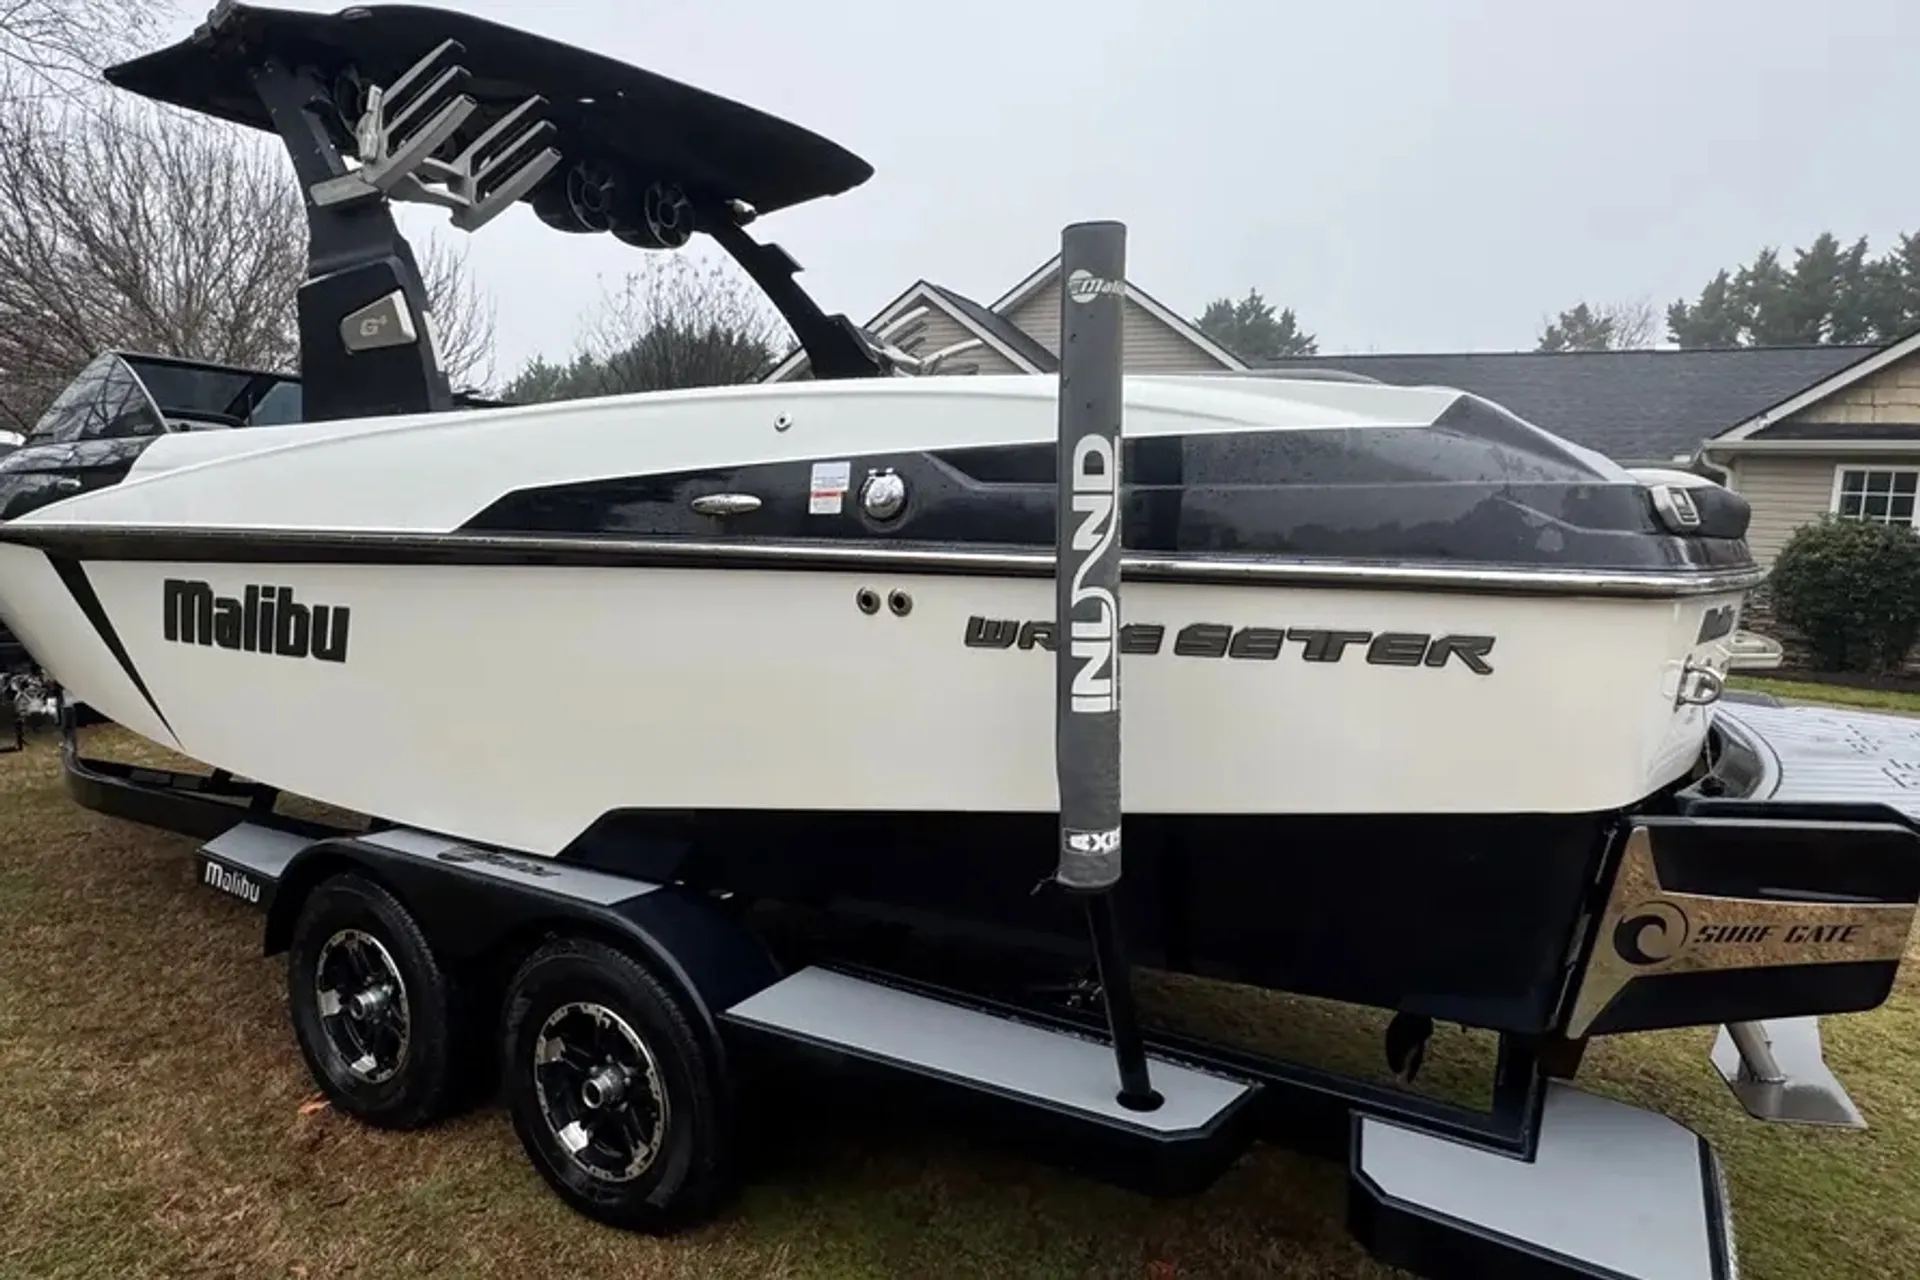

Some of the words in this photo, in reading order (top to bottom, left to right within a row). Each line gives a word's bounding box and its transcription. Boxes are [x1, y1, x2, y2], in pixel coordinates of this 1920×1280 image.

[163, 578, 350, 663] Malibu
[963, 615, 1165, 654] WAE
[1173, 622, 1496, 676] SETTER
[204, 861, 260, 903] Malibu
[1695, 924, 1779, 943] SURF
[1783, 924, 1864, 943] GATE
